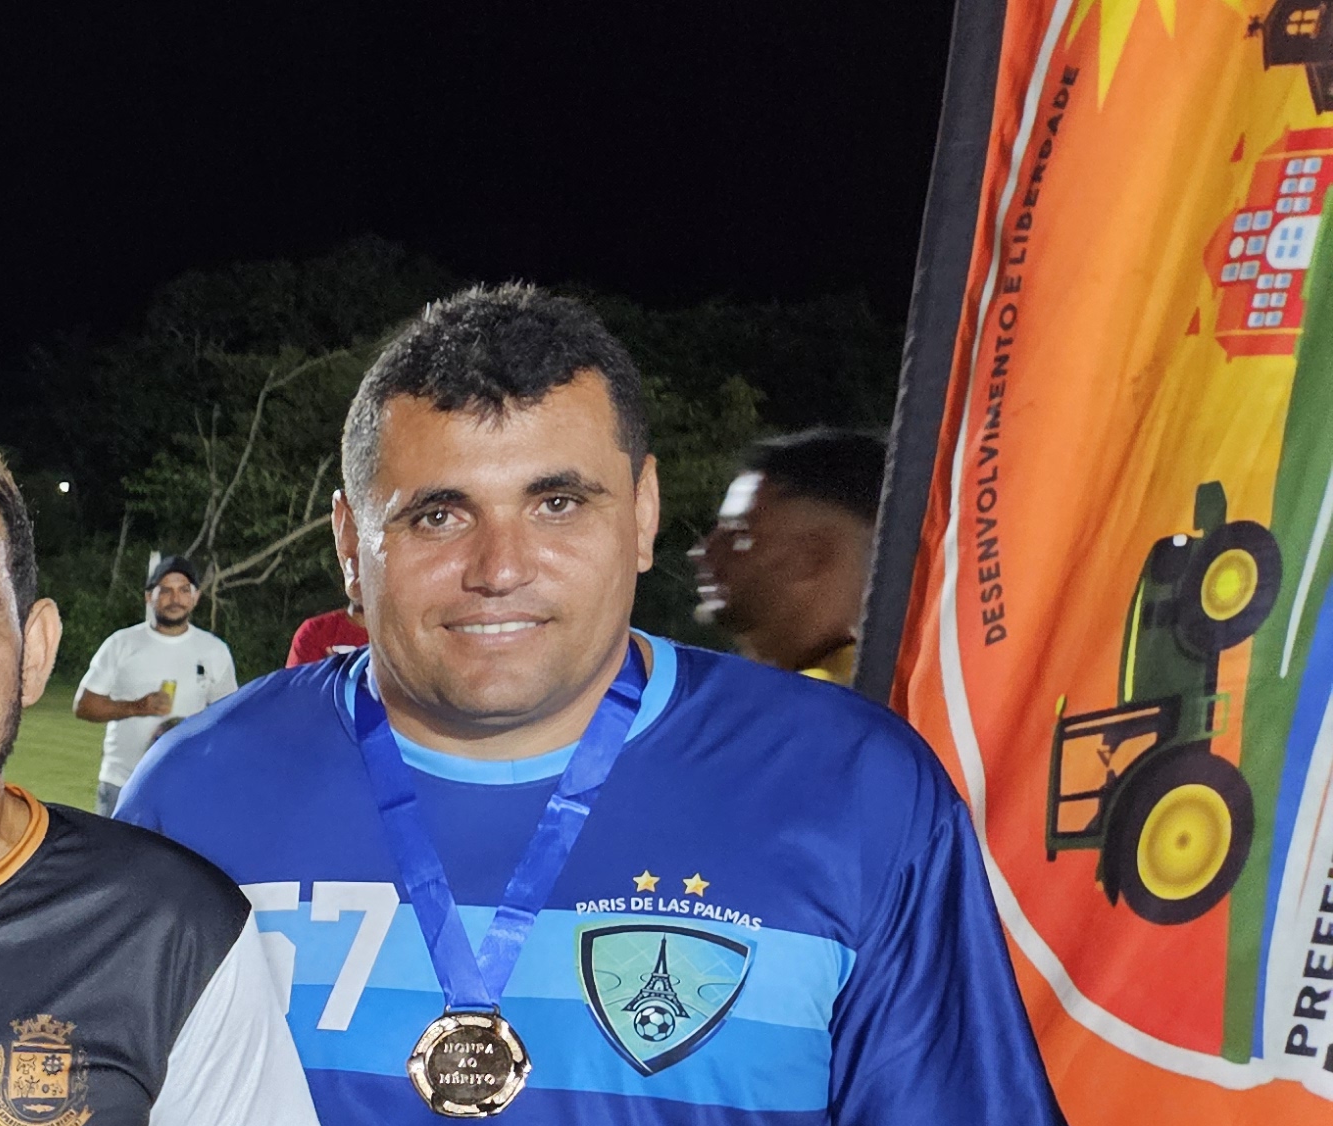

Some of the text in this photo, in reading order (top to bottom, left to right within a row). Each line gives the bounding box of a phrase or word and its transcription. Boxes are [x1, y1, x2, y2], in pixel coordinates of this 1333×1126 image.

[976, 303, 1018, 647] DESENVOLVIMENTO
[1003, 275, 1022, 295] E
[575, 897, 763, 932] PARIS DE LAS PALMAS
